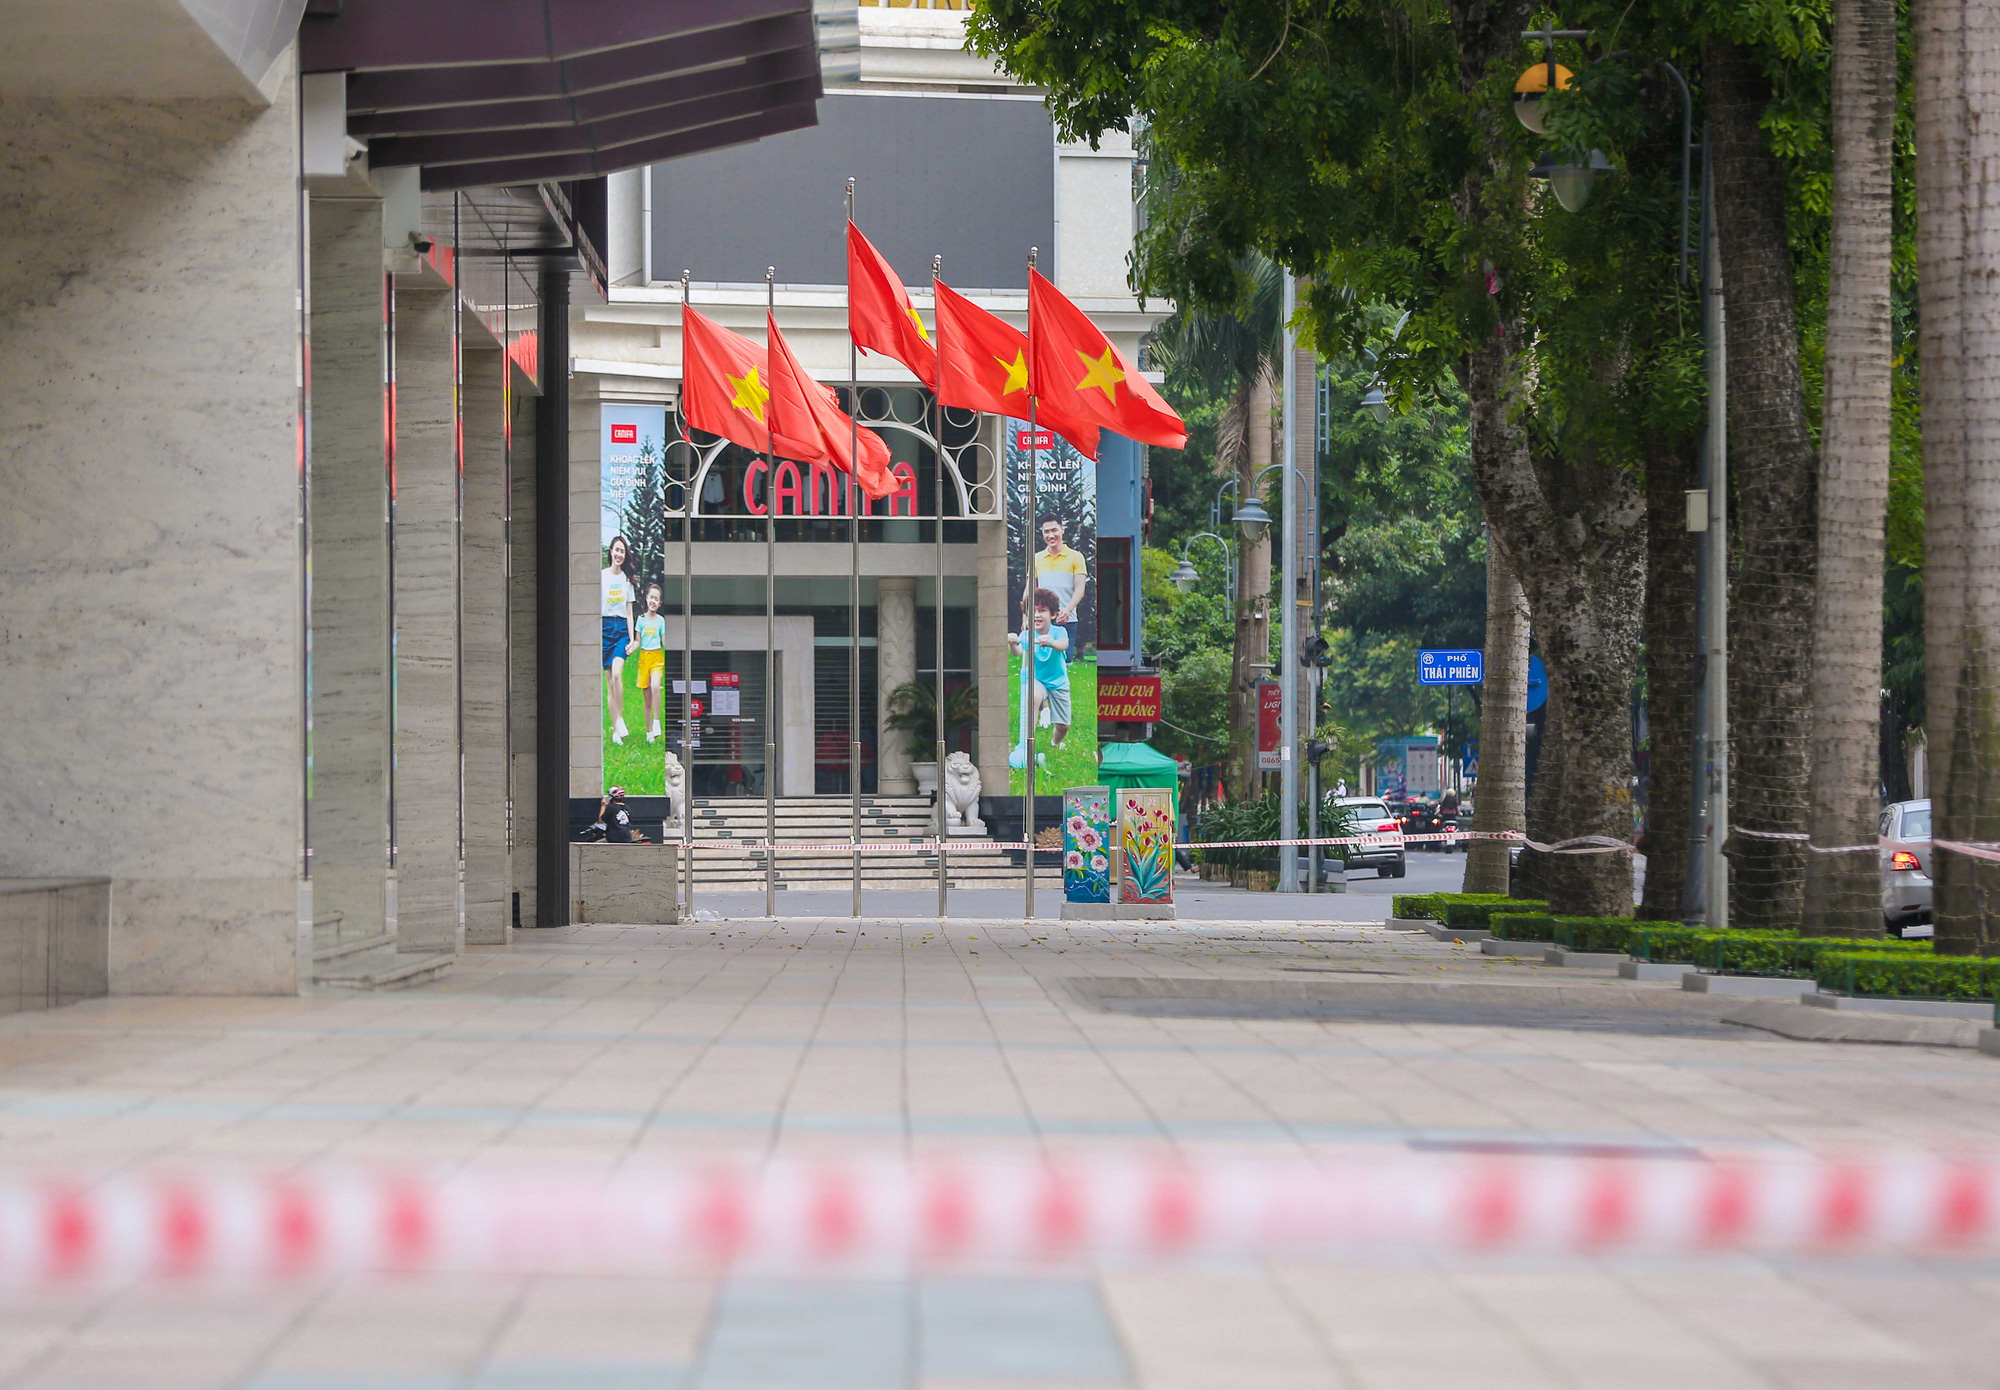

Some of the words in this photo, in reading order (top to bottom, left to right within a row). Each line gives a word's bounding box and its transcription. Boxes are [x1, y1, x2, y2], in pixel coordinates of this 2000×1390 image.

[1022, 435, 1049, 445] CAIFA
[1059, 458, 1080, 470] LÊN
[1017, 472, 1046, 481] NIM
[1048, 472, 1067, 481] VUI
[1039, 481, 1067, 492] ĐÌNH
[1017, 495, 1042, 504] VIT
[1447, 653, 1468, 662] PHỐ
[1423, 664, 1447, 679] THÁI
[1449, 664, 1479, 679] PHIÊN
[1099, 682, 1129, 697] RIÊU
[1130, 685, 1155, 697] CUA
[1097, 704, 1121, 716] CUA
[1122, 700, 1157, 717] ĐỒNG
